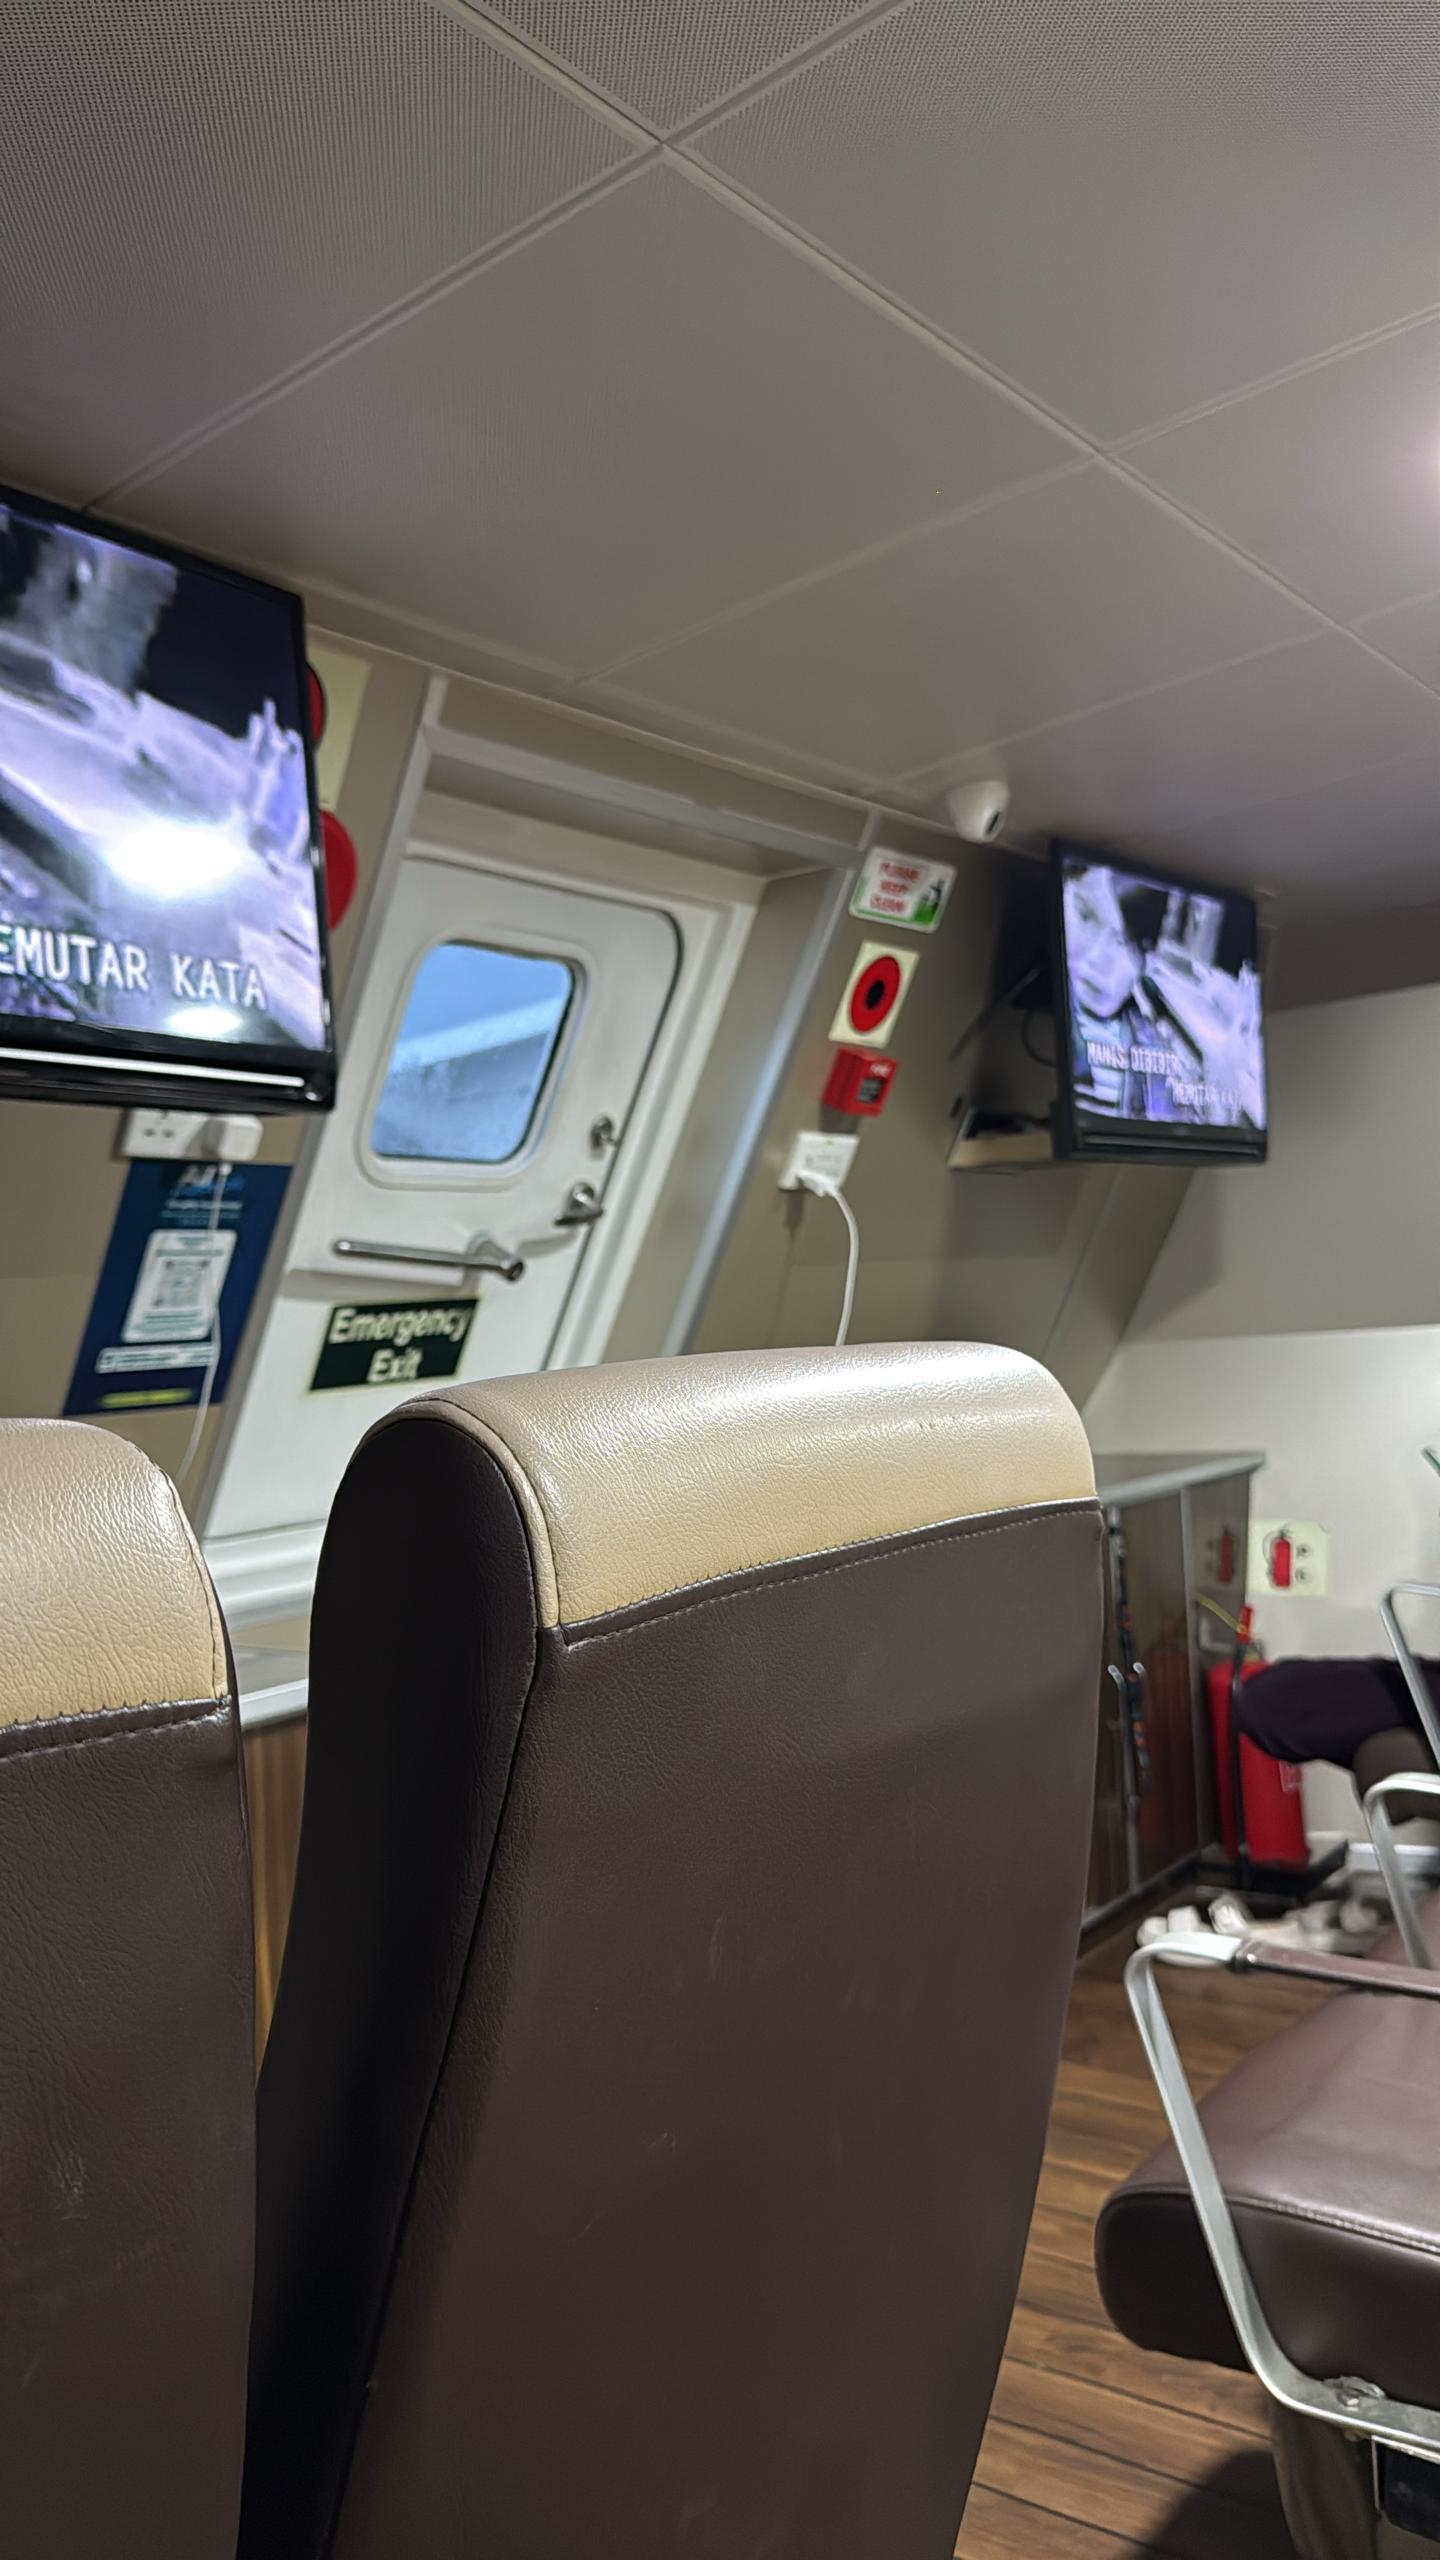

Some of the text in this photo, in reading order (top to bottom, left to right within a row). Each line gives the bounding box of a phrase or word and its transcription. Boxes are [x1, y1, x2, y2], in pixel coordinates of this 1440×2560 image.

[169, 952, 267, 1010] KATA
[328, 1307, 472, 1347] Emergency
[366, 1347, 423, 1383] Exit
